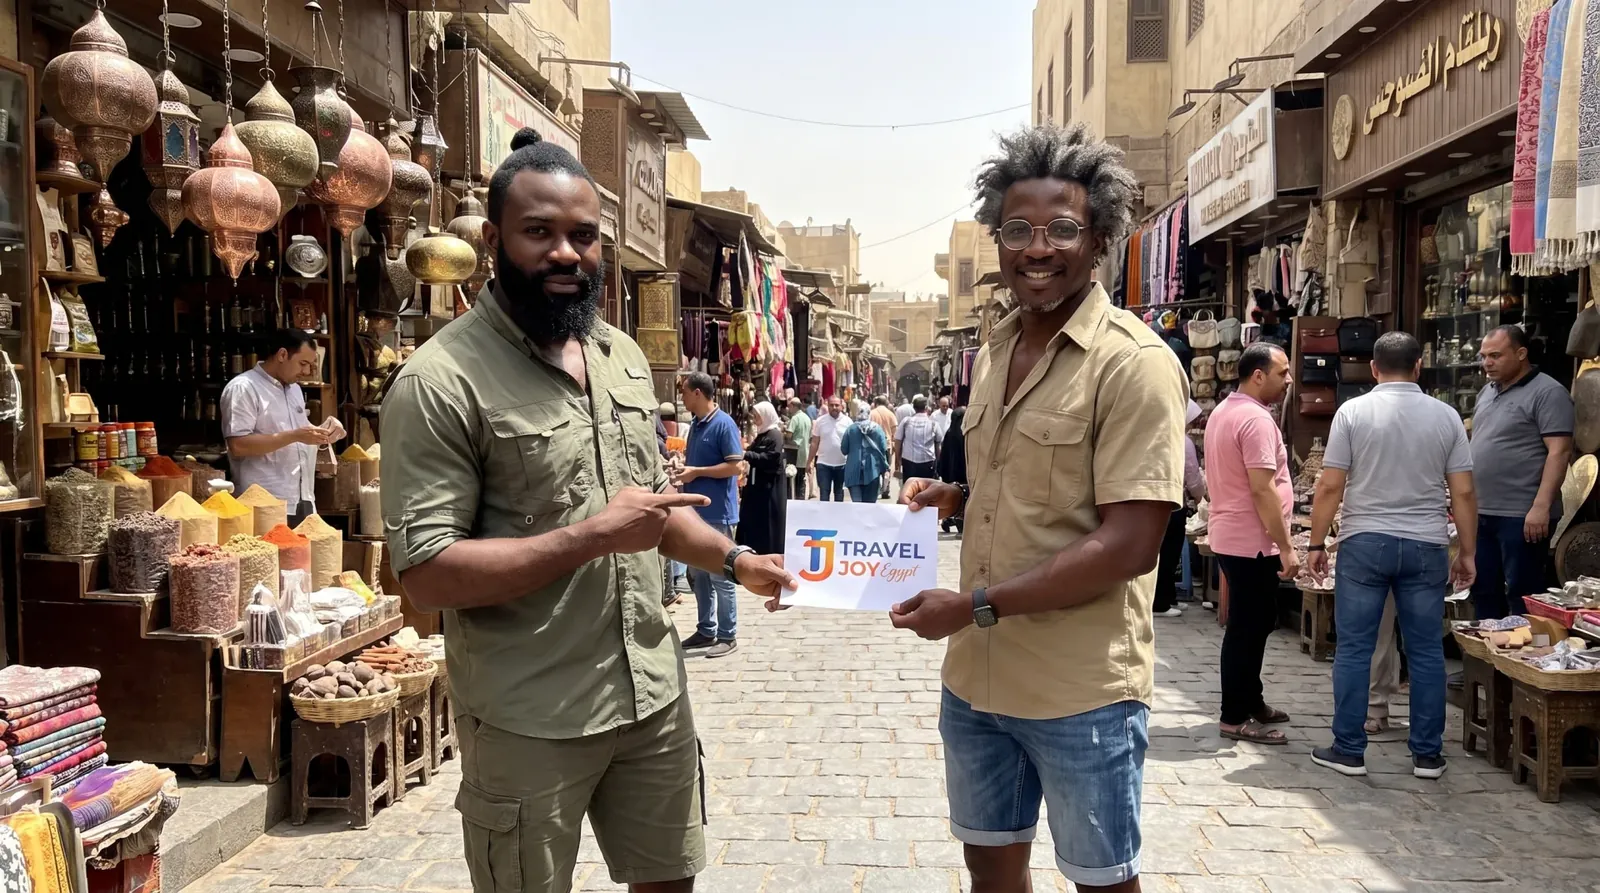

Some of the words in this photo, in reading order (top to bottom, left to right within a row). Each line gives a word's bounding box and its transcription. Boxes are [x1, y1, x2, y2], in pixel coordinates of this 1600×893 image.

[839, 540, 926, 560] TRAVEL
[838, 561, 880, 577] JOY
[880, 562, 921, 583] Egypt
